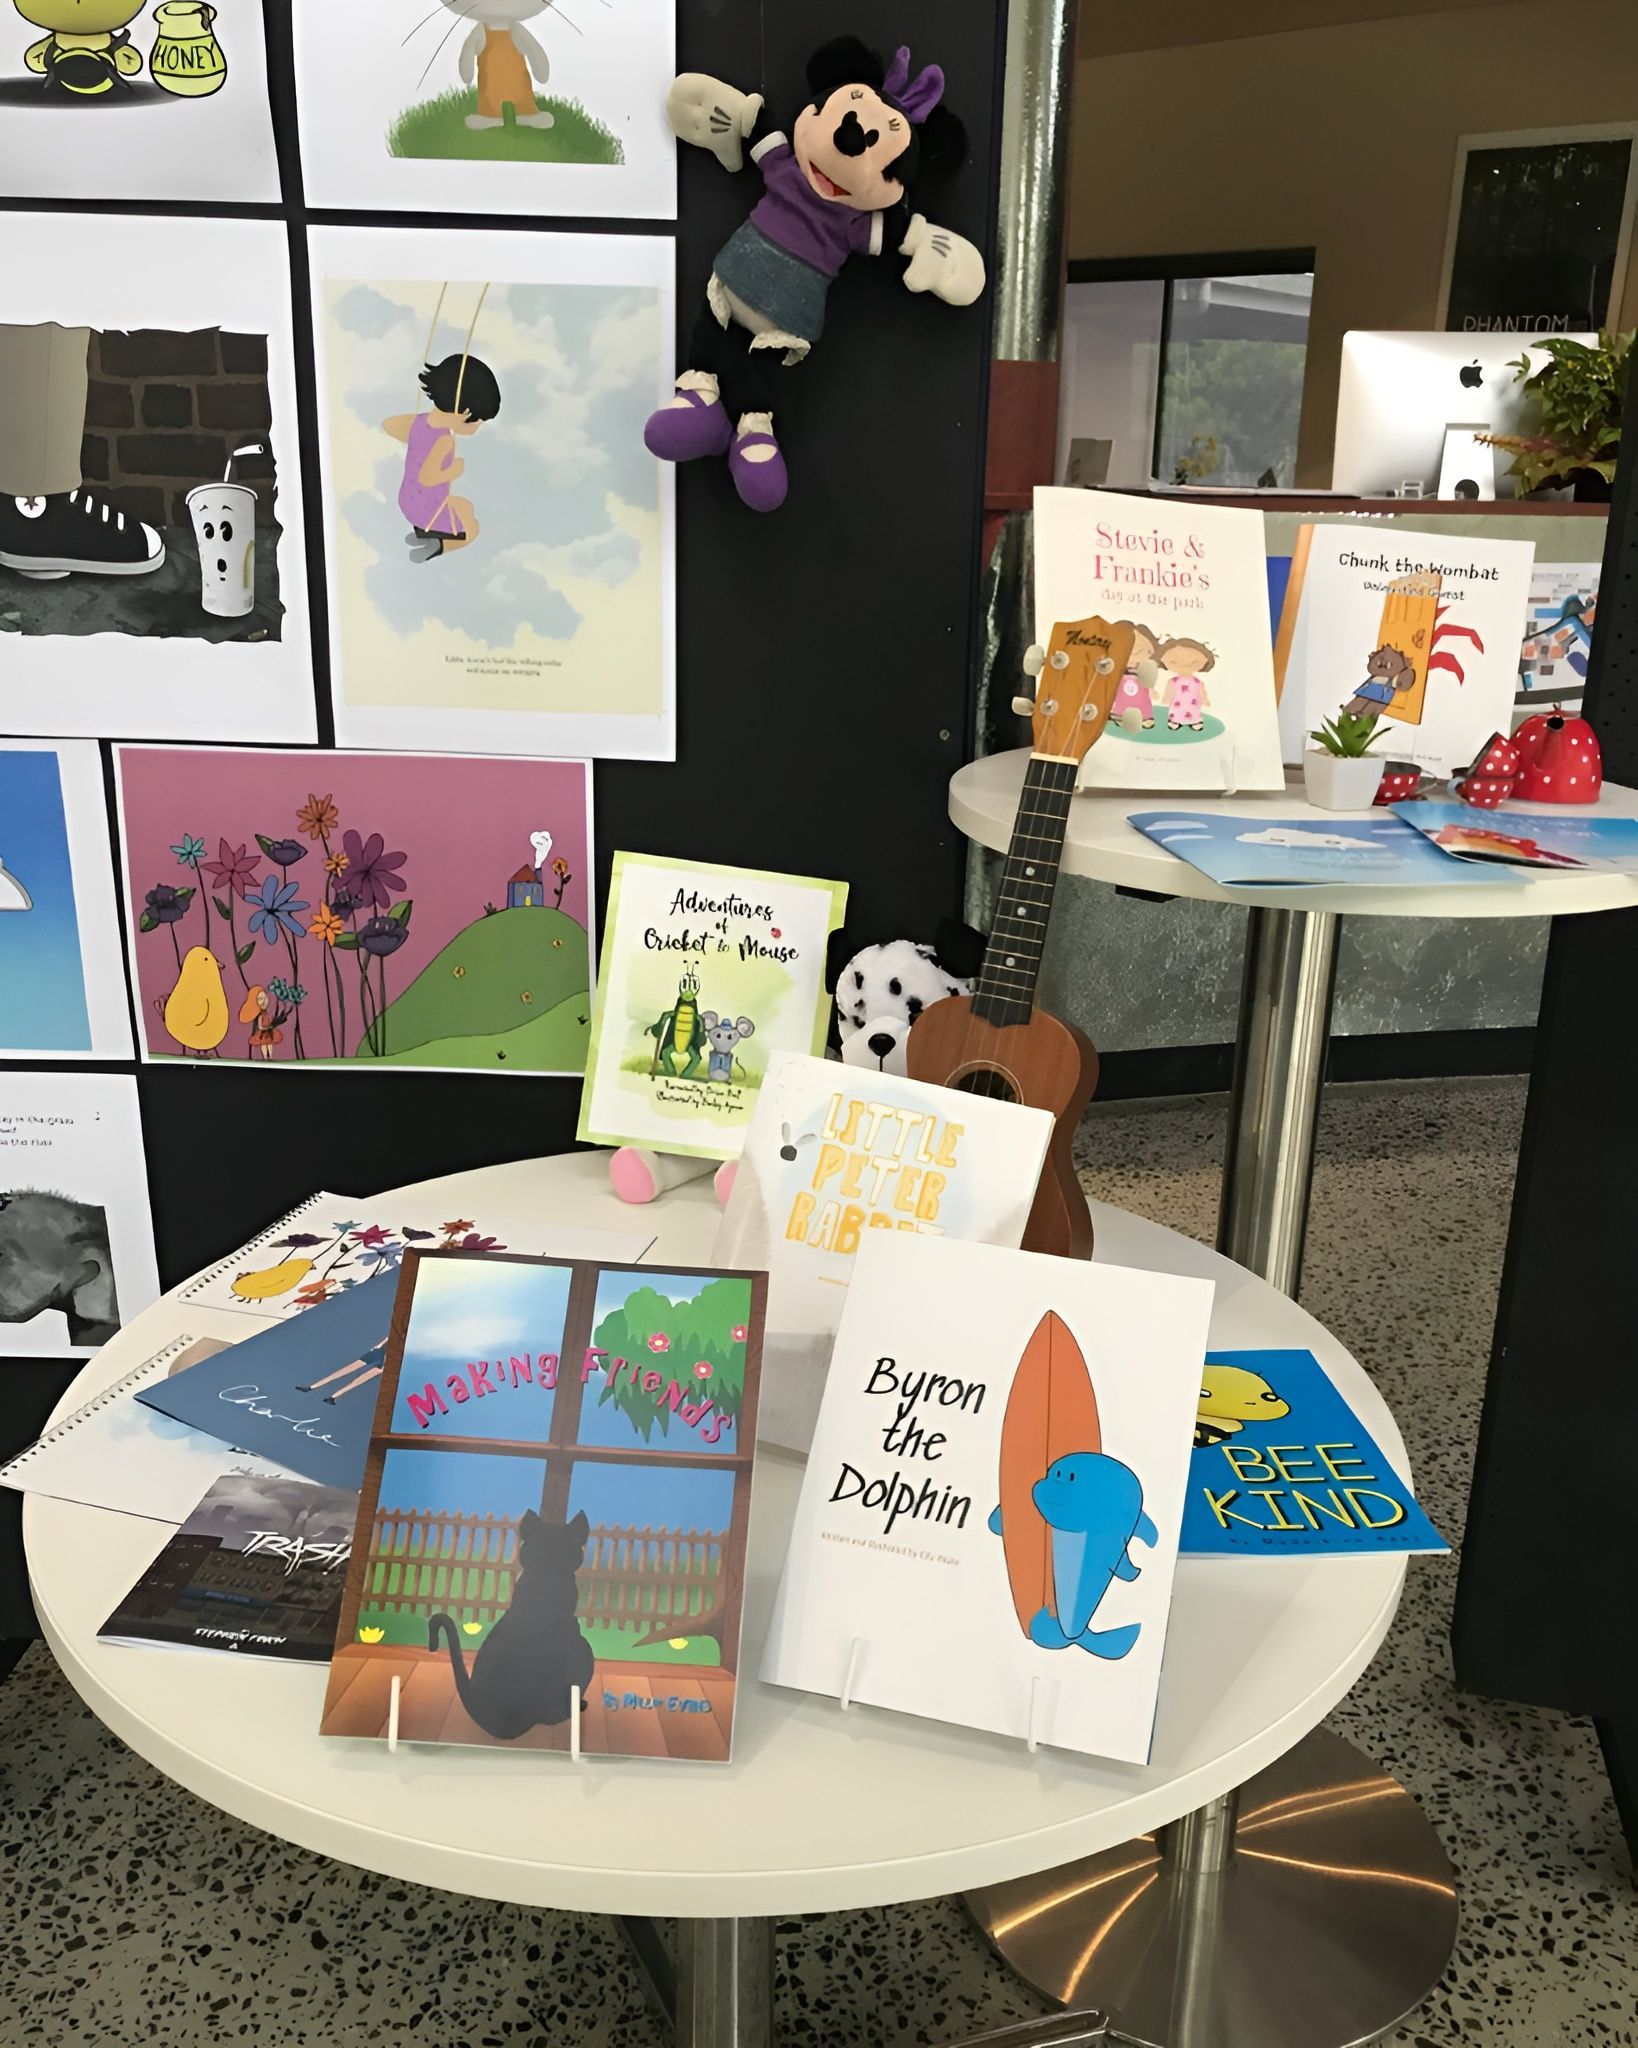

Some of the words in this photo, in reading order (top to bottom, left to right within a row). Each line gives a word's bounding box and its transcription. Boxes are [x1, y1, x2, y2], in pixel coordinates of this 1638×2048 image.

[154, 42, 216, 70] HONEY
[1463, 314, 1569, 332] PHANTOM
[1095, 521, 1174, 555] Stevie
[1184, 534, 1205, 558] &
[1093, 554, 1210, 590] Frankie's
[1339, 551, 1389, 572] Chunk
[1396, 557, 1423, 575] the
[1430, 562, 1499, 581] Wombat
[670, 888, 774, 921] Adventures
[644, 927, 714, 955] Cricket
[738, 935, 799, 963] Mouse
[715, 917, 729, 934] of
[821, 1093, 965, 1168] LITTLE
[812, 1143, 947, 1221] PETER
[785, 1191, 945, 1255] RAB
[864, 1357, 986, 1420] Byron
[881, 1402, 947, 1460] the
[1221, 1443, 1377, 1482] BEE
[828, 1462, 971, 1535] Dolphin
[1203, 1487, 1406, 1530] KIND
[241, 1530, 352, 1577] TRASH
